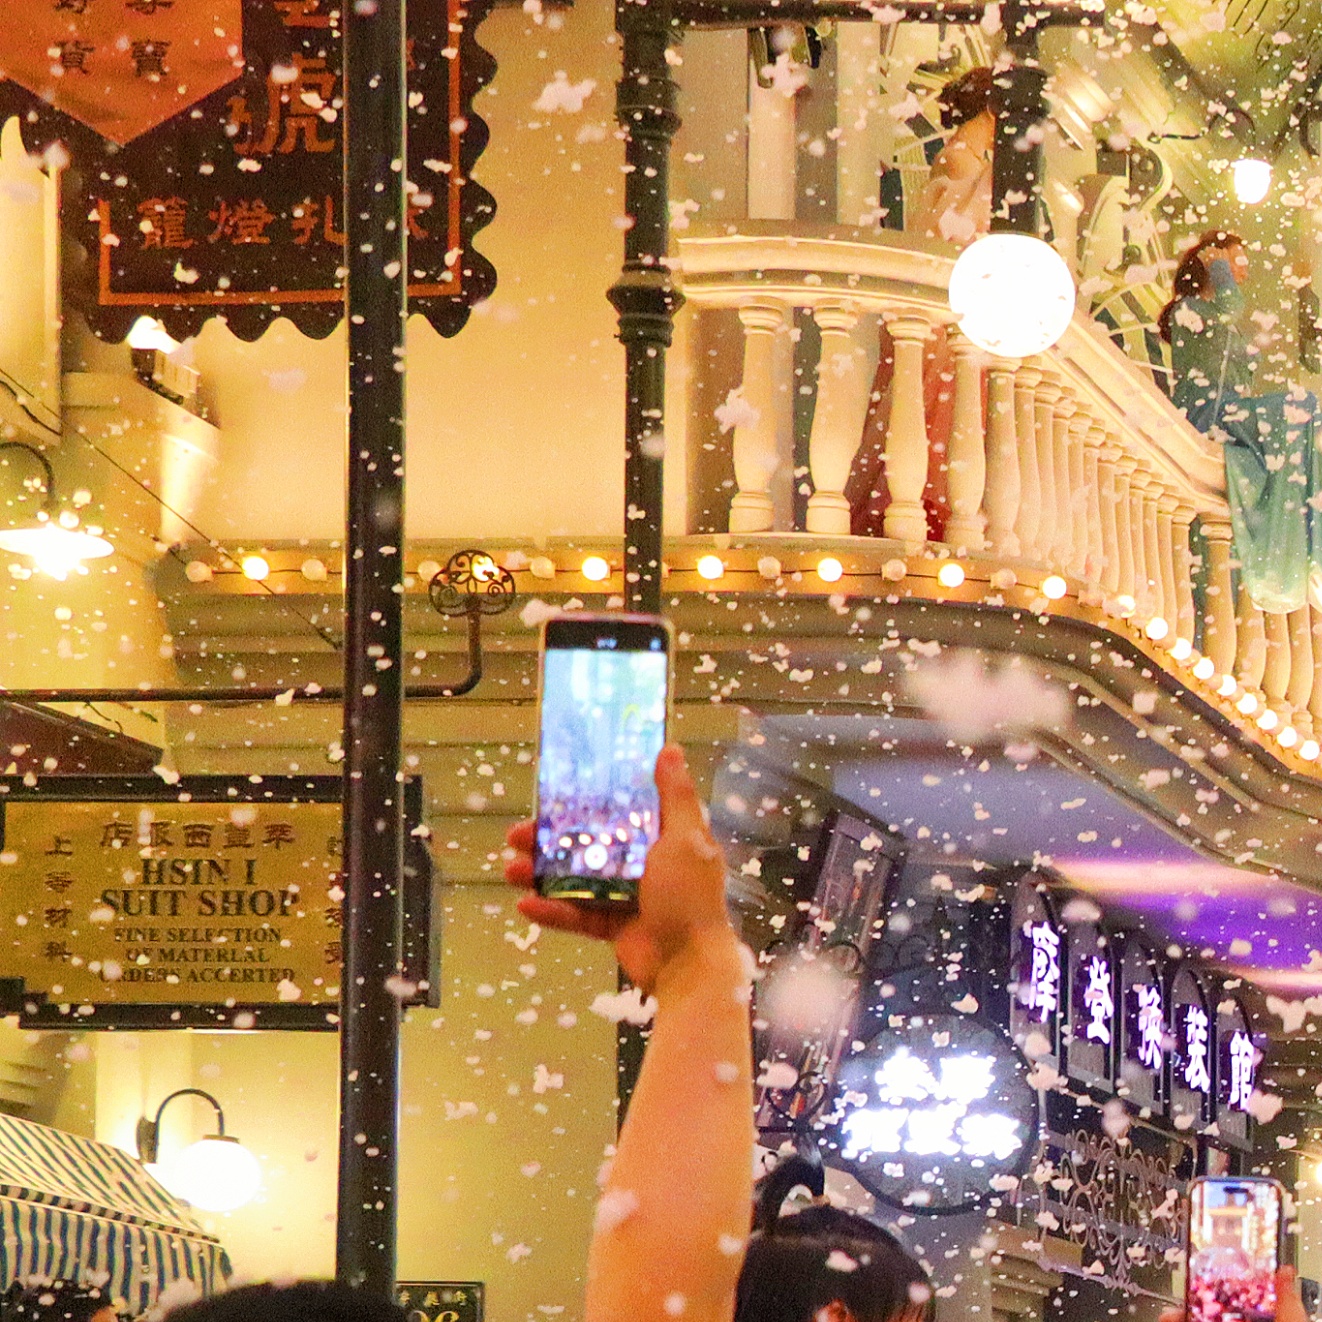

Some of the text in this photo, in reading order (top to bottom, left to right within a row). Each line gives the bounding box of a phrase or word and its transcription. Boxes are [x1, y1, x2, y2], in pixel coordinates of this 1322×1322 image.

[141, 858, 258, 886] HSIN I
[101, 888, 299, 917] SUIT SHOP
[114, 927, 160, 943] FINE
